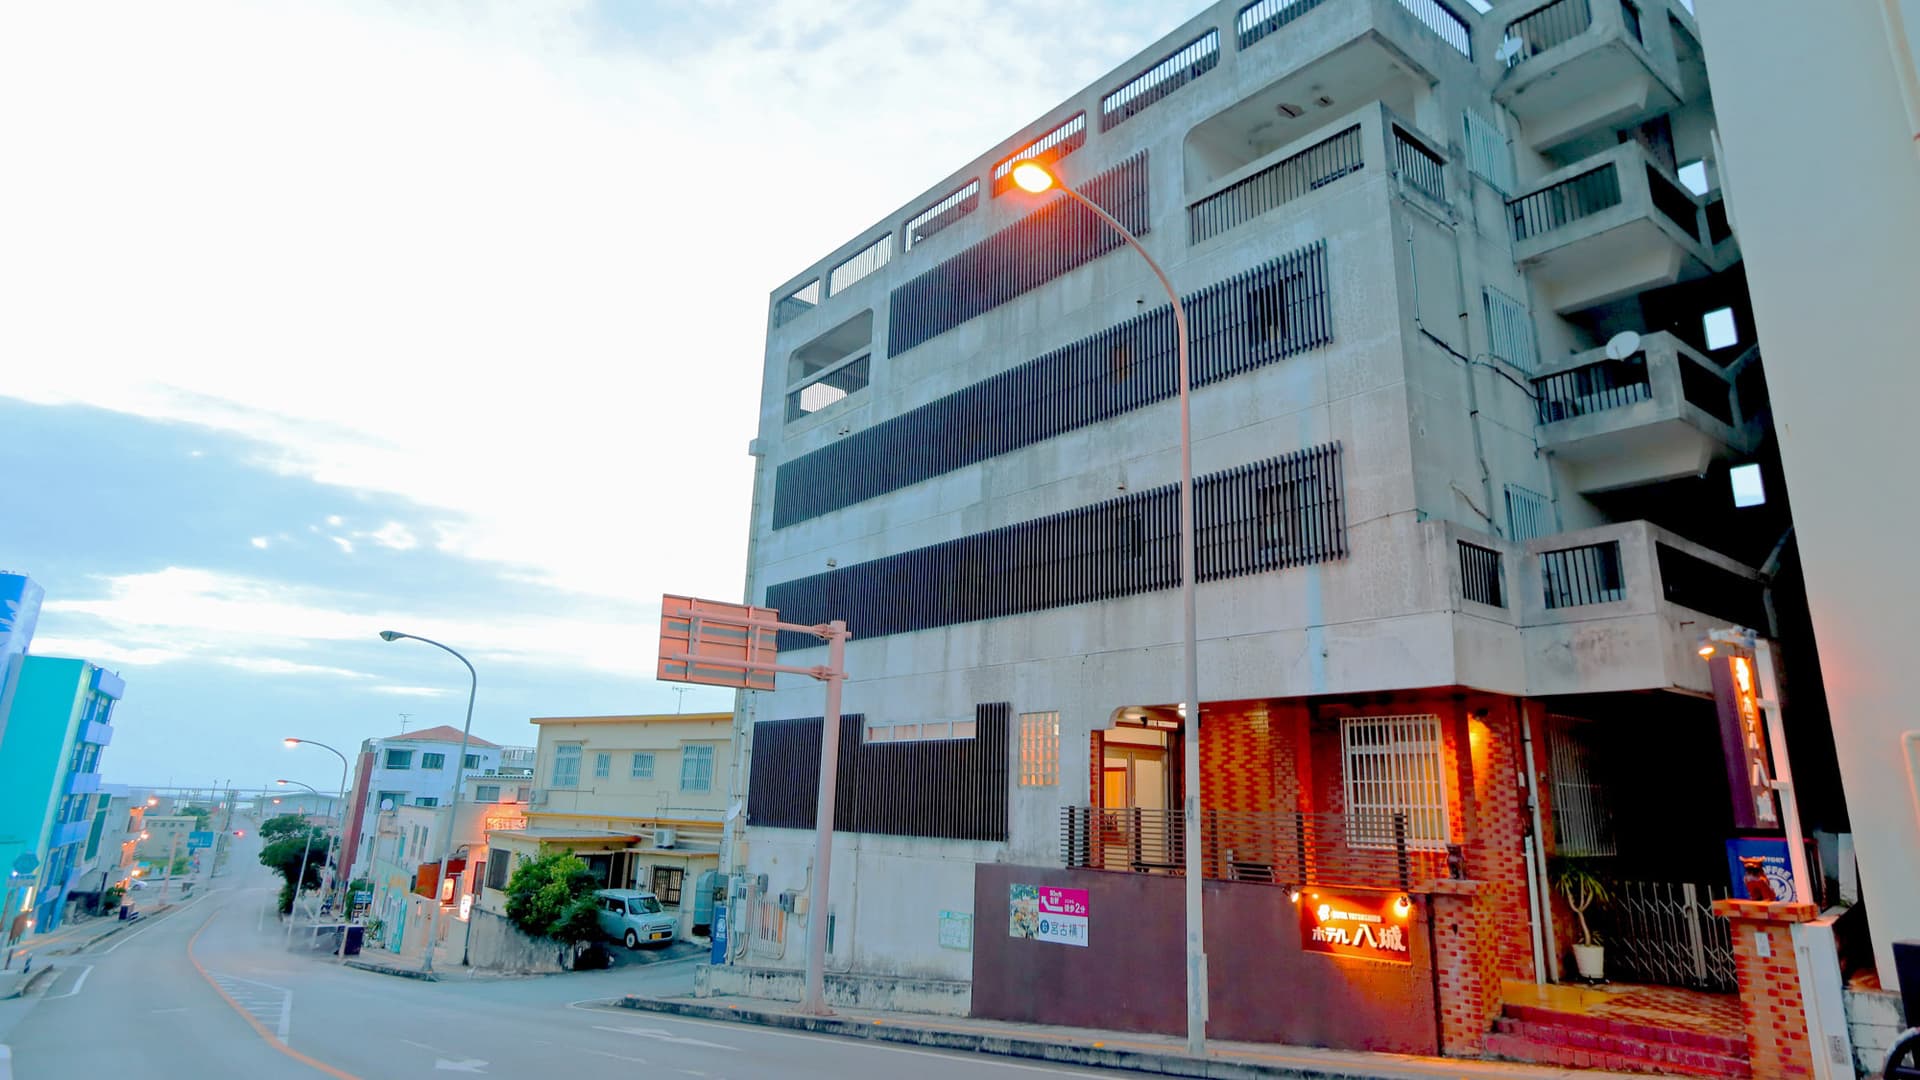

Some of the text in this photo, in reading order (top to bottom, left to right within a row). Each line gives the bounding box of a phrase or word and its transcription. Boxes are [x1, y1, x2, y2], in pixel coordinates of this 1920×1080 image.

[1050, 921, 1086, 939] 宮古横丁
[1312, 924, 1406, 951] ホテル八城
